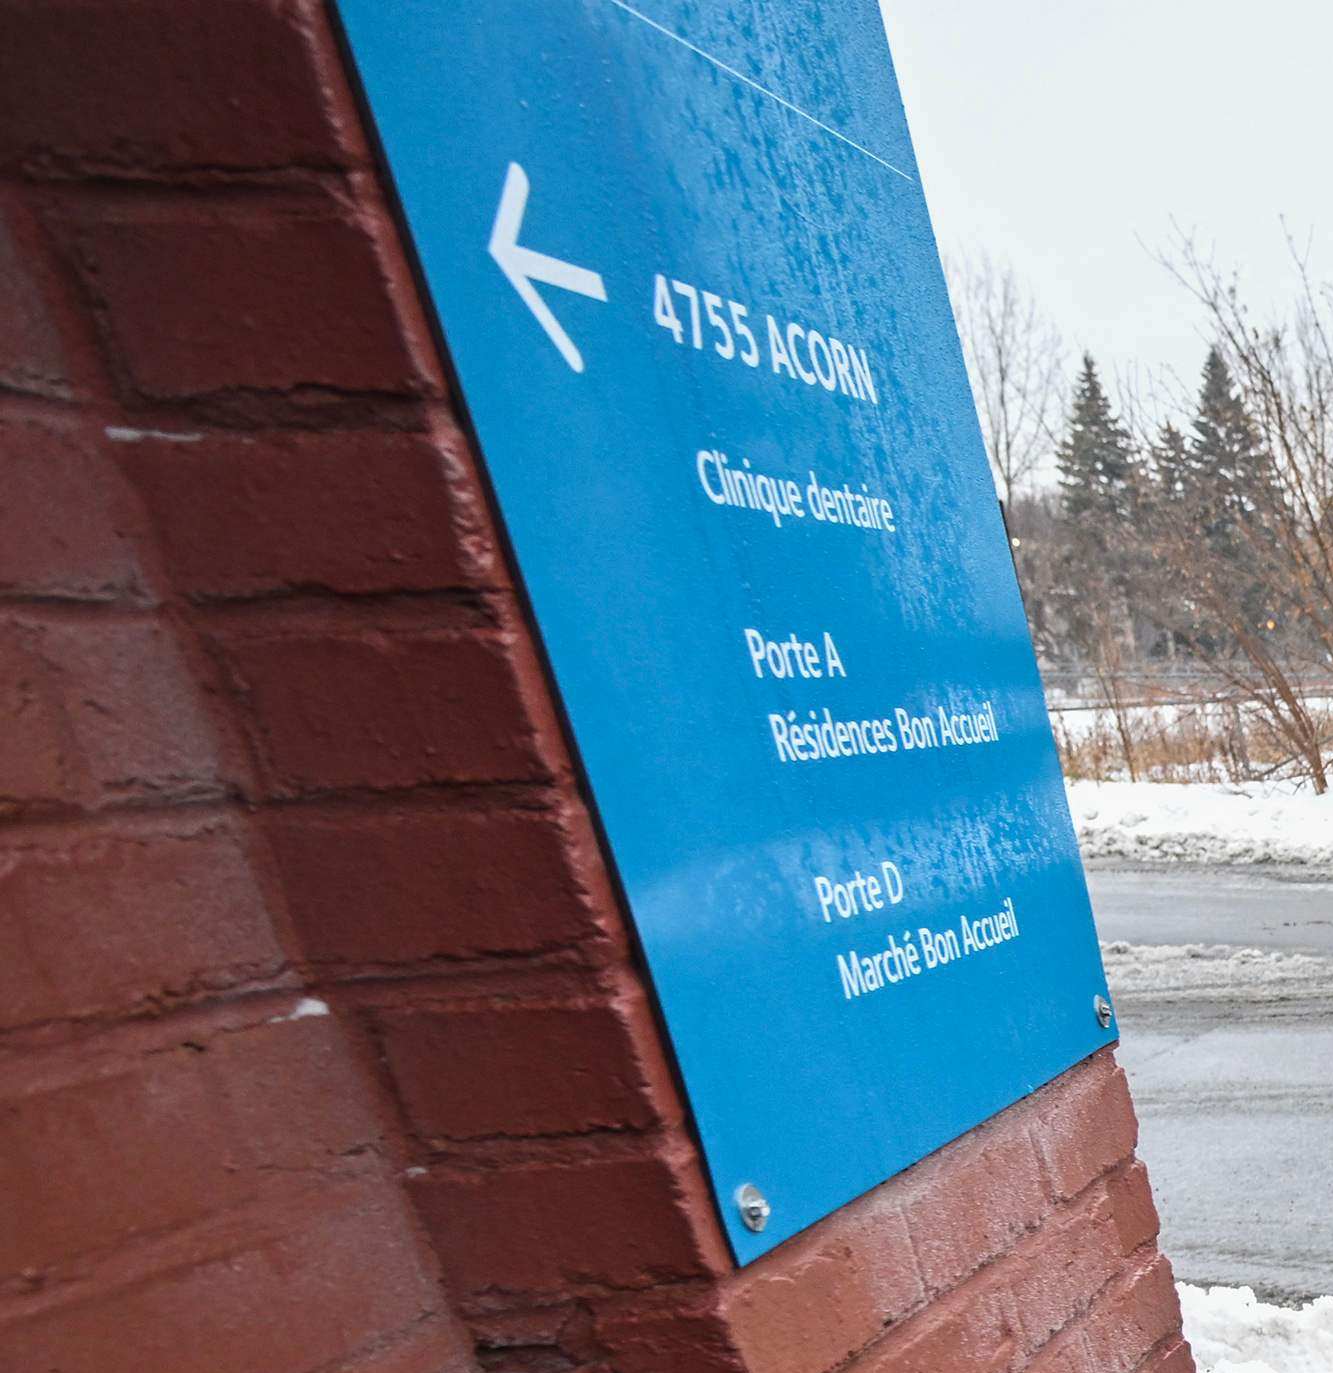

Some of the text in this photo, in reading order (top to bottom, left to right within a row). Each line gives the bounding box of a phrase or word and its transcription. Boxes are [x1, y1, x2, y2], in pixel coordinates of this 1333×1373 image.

[653, 272, 878, 405] 4755 ACORN
[696, 450, 895, 532] Clinique dentaire
[743, 628, 847, 679] Porte A
[768, 700, 999, 762] Résidences Bon Accueil
[814, 860, 904, 923] Porte D
[836, 896, 1020, 1000] Marché Bon Accueil
